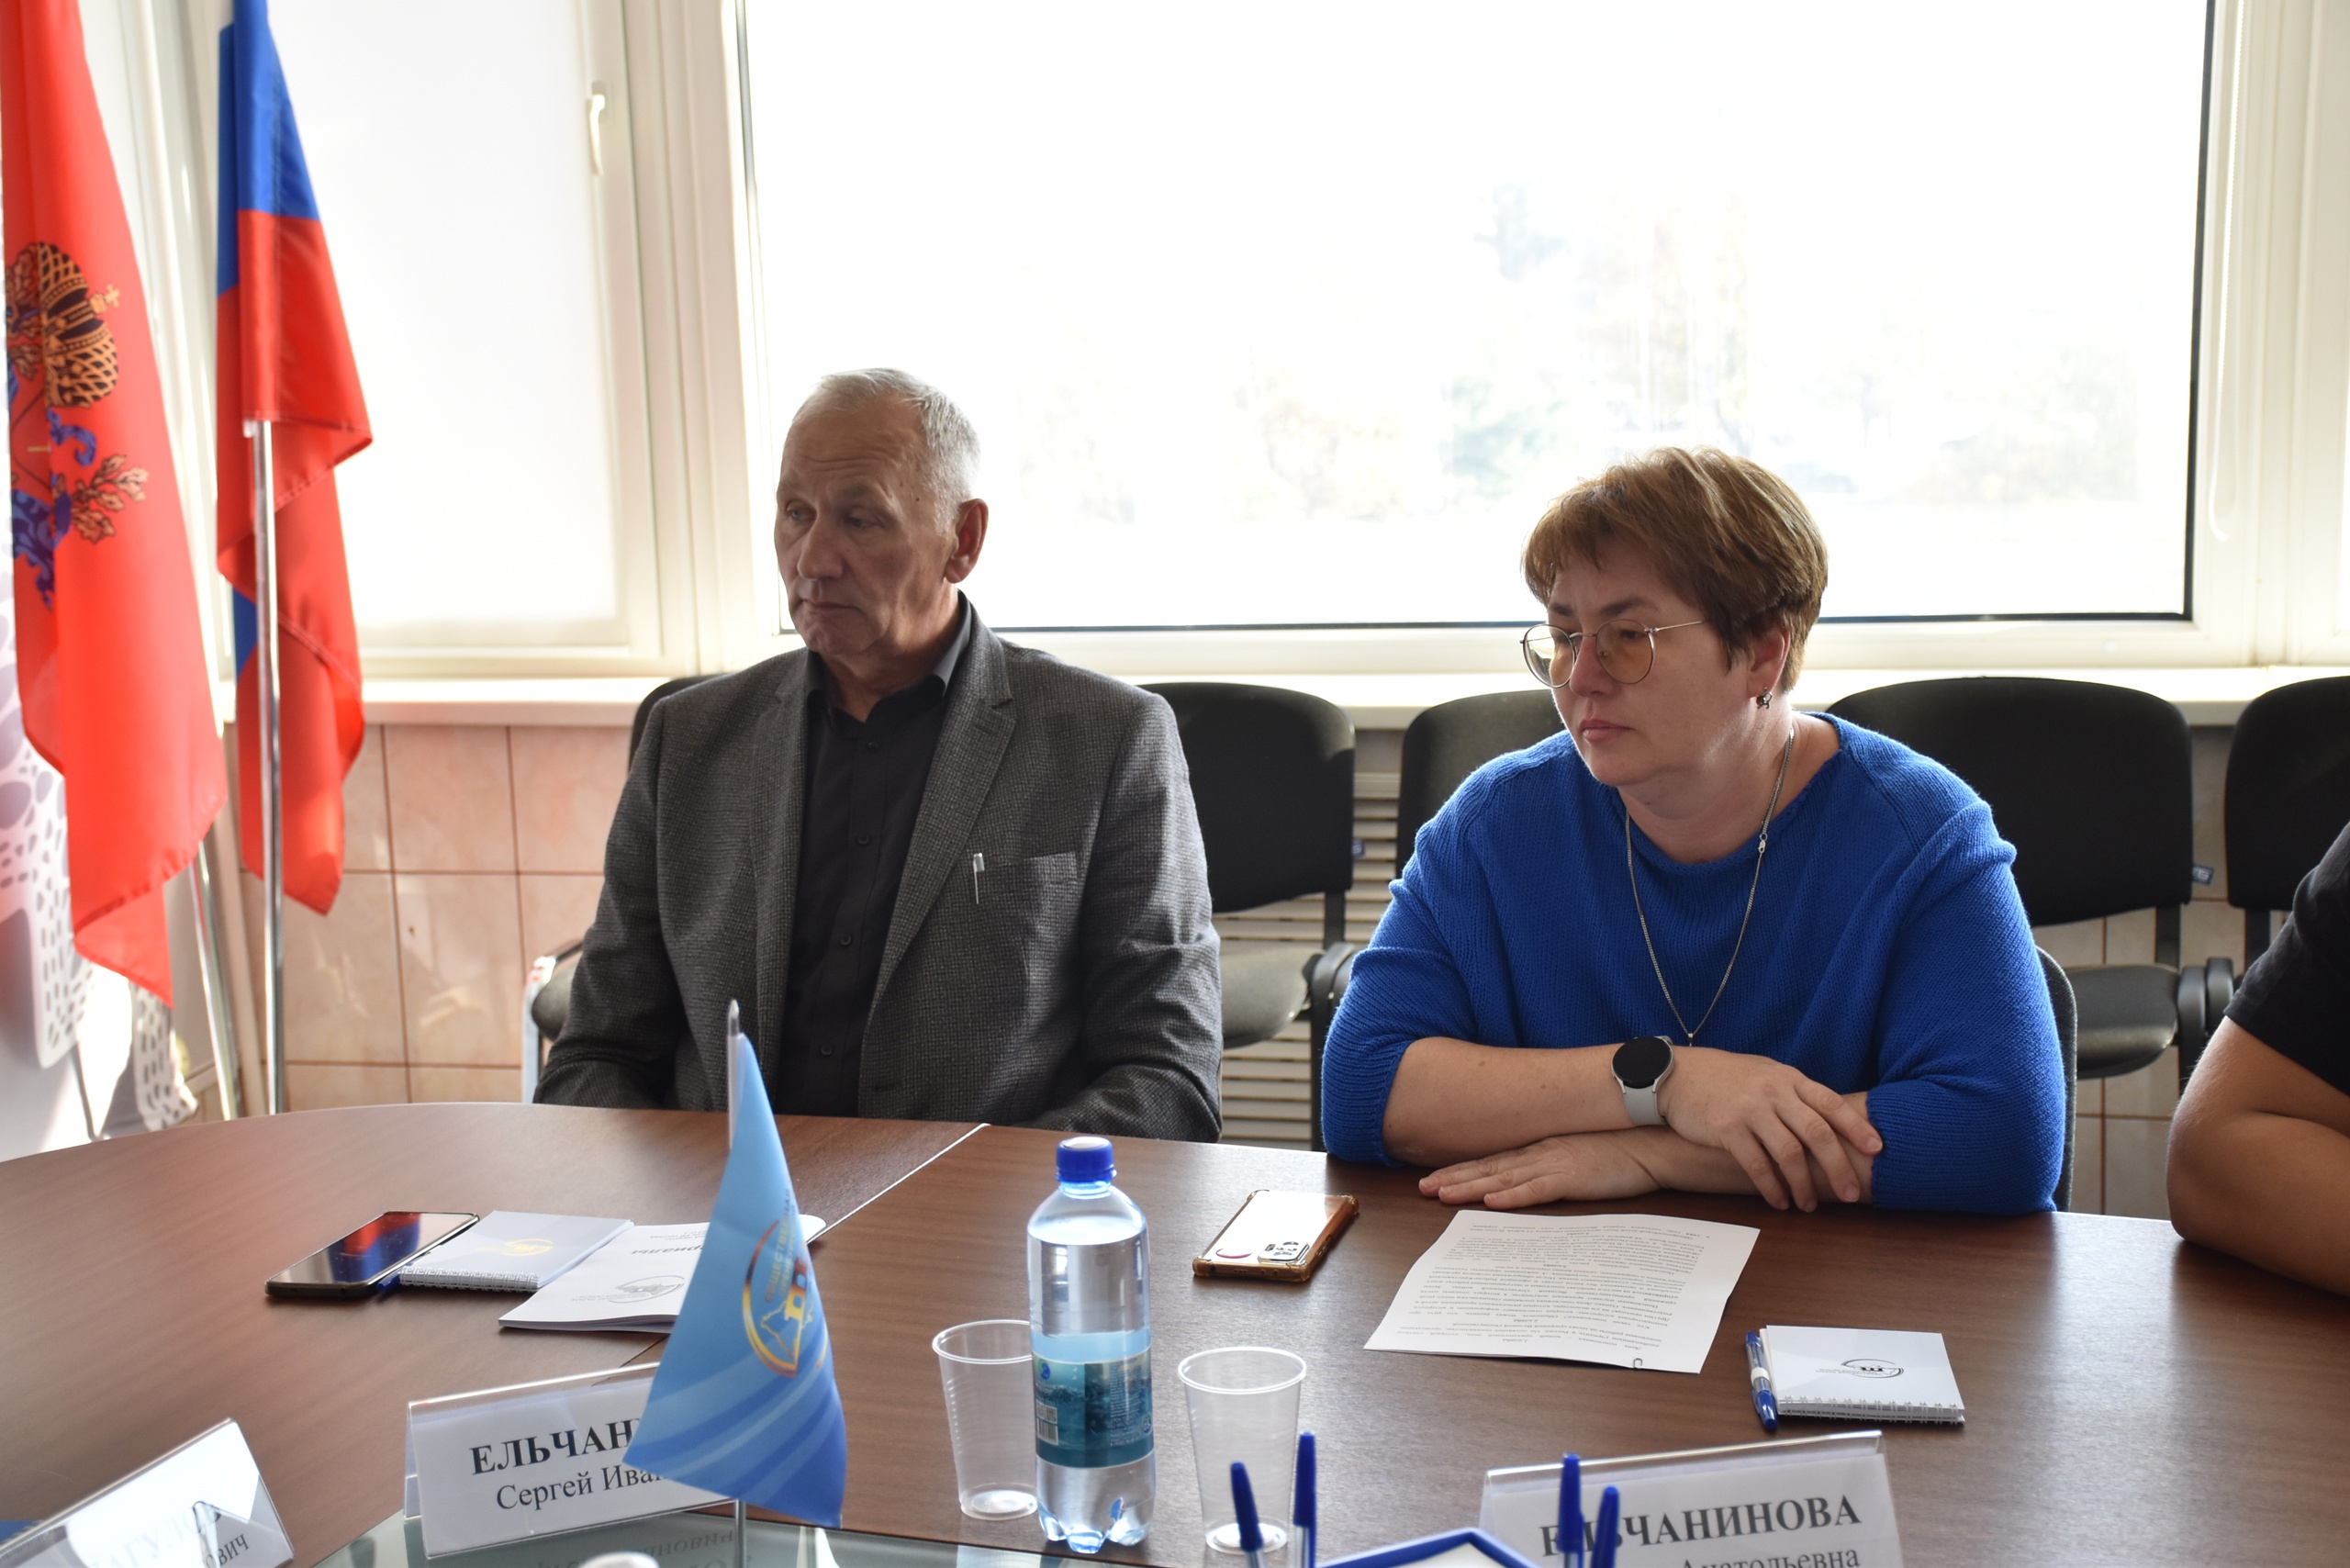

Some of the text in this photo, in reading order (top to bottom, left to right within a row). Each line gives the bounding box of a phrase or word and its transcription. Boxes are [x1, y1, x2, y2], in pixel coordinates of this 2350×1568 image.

[631, 1244, 703, 1255] риалы
[469, 1417, 640, 1475] ЕЛЬЧАН
[496, 1471, 593, 1511] Сергей
[1539, 1495, 1862, 1558] ЕЧАНИНОВА
[1681, 1548, 1861, 1568] ольевна
